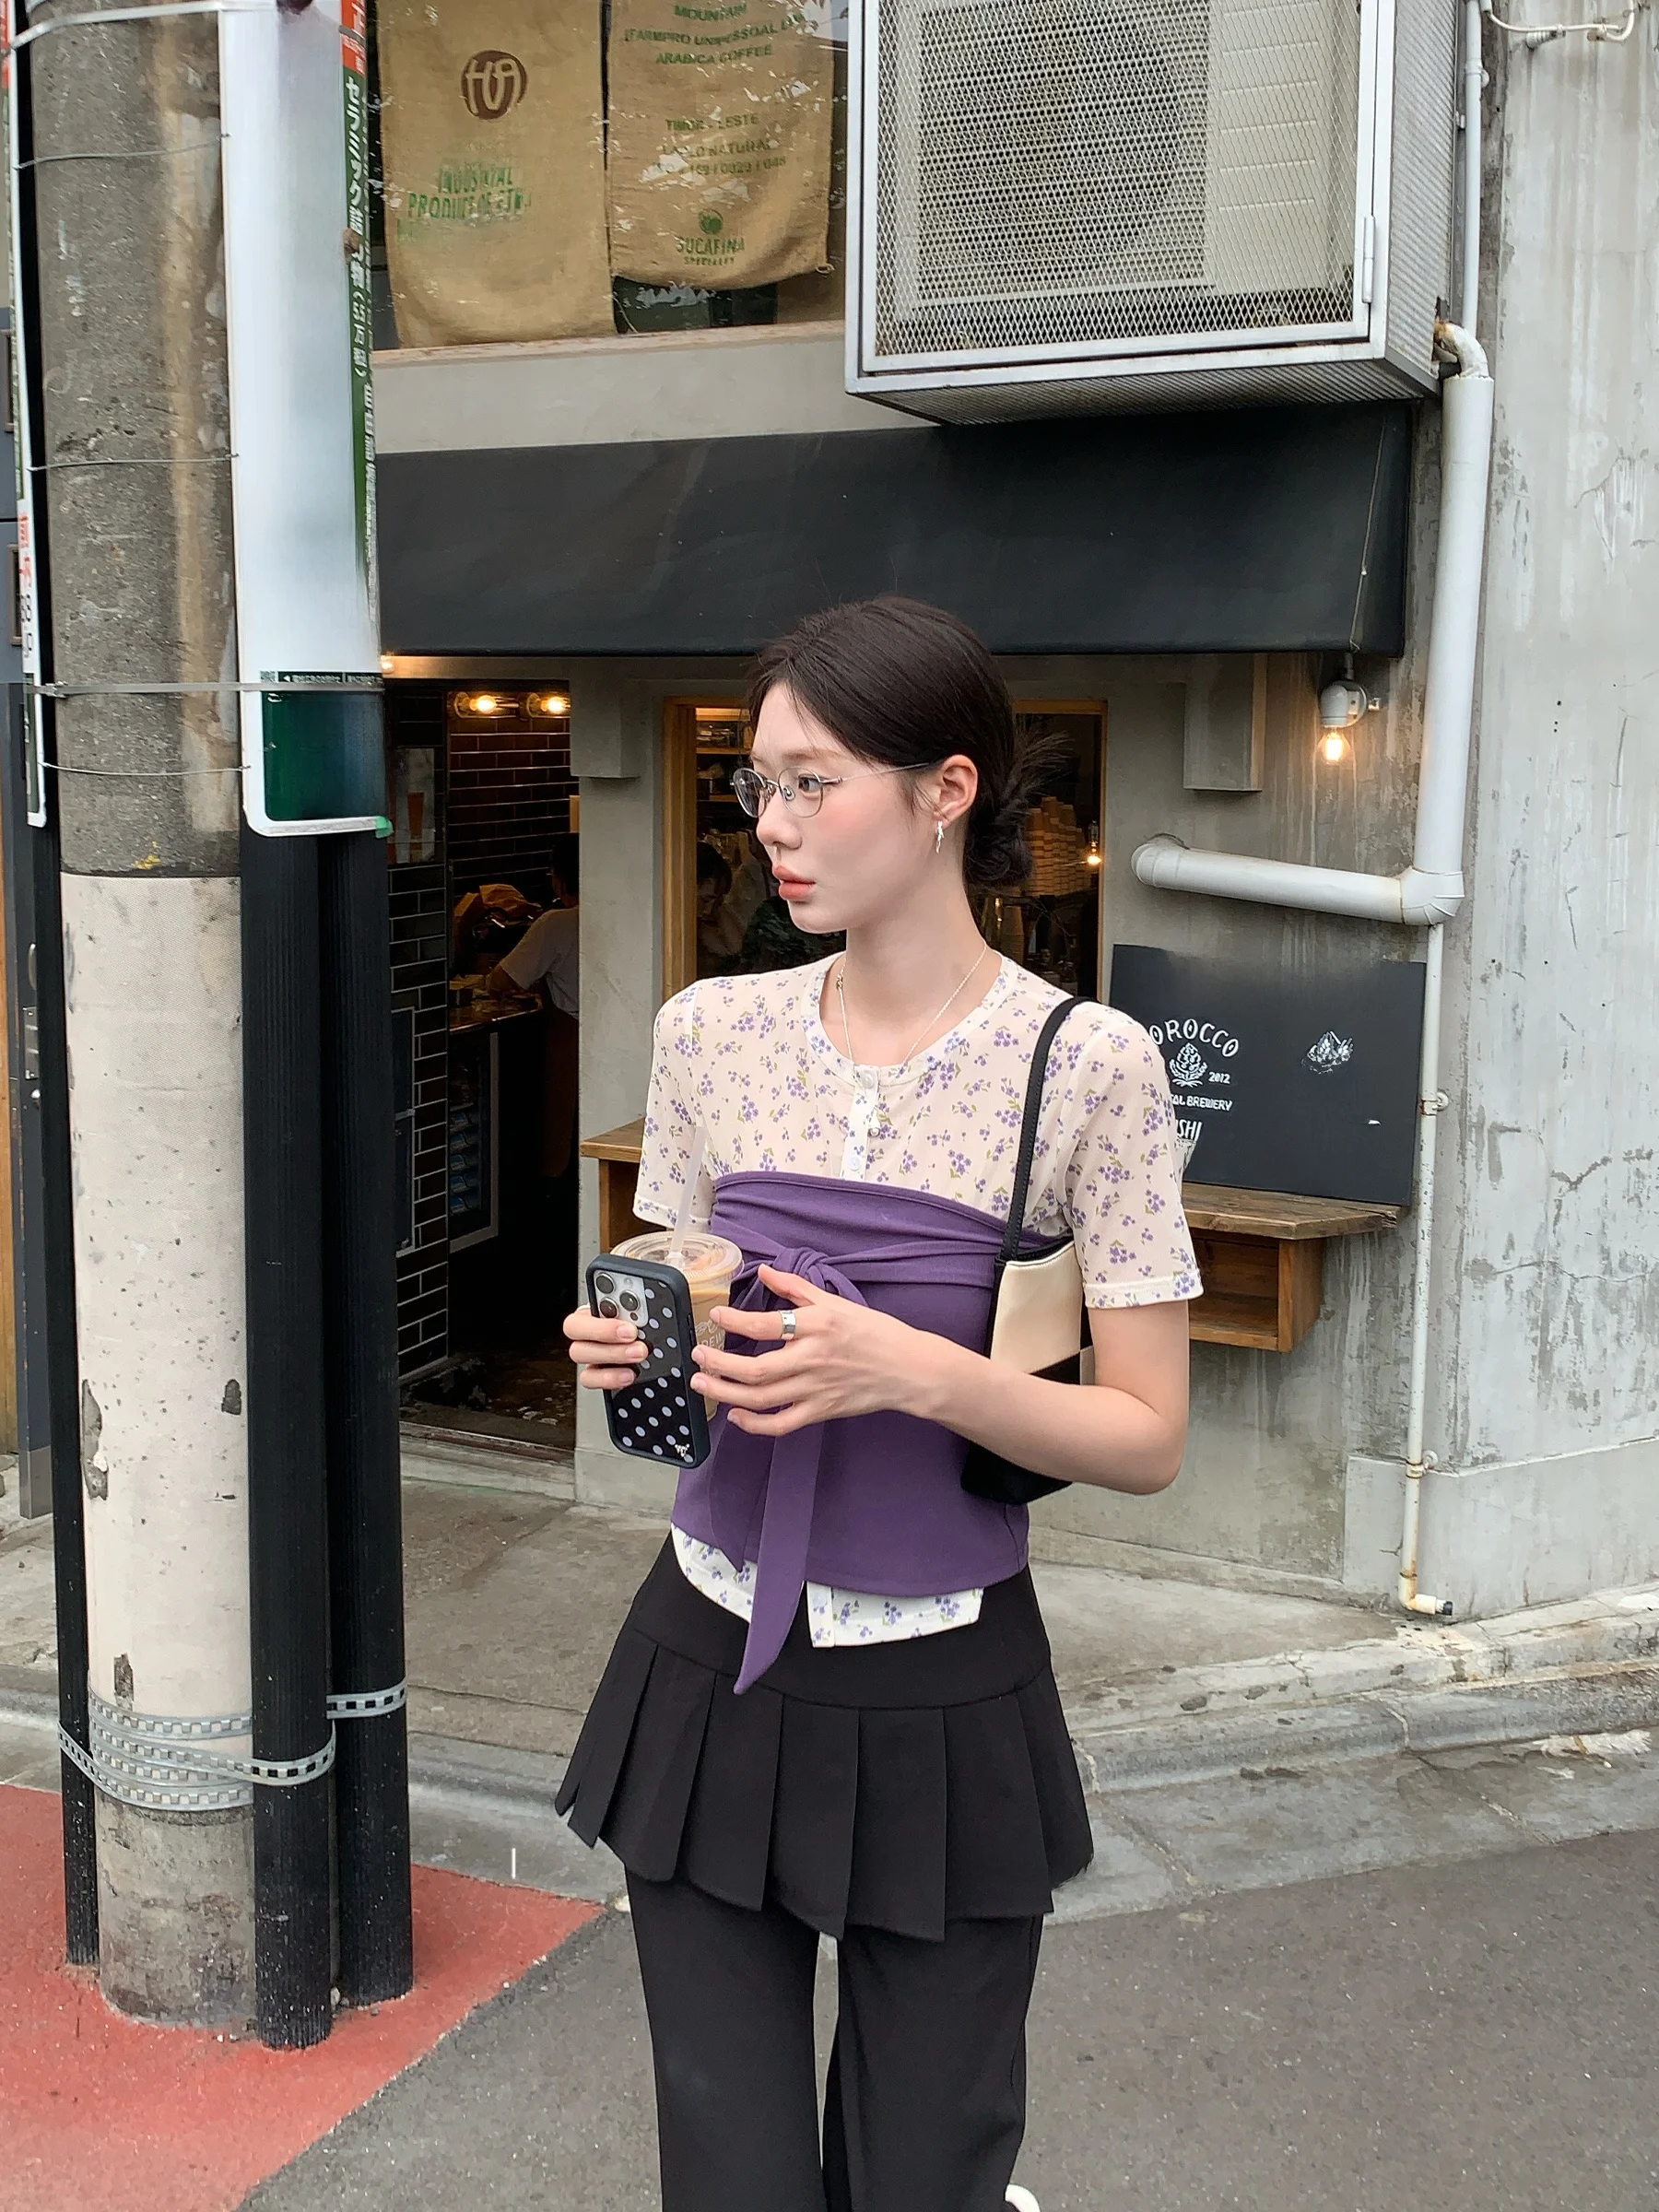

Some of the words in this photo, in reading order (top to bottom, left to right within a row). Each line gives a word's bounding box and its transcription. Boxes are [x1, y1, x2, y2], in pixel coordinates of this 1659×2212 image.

[719, 45, 772, 63] COFFEE
[708, 139, 776, 157] NATURA
[1148, 1018, 1240, 1057] OROCCO
[1207, 1071, 1231, 1084] 2012
[1186, 1095, 1233, 1112] BREWERY
